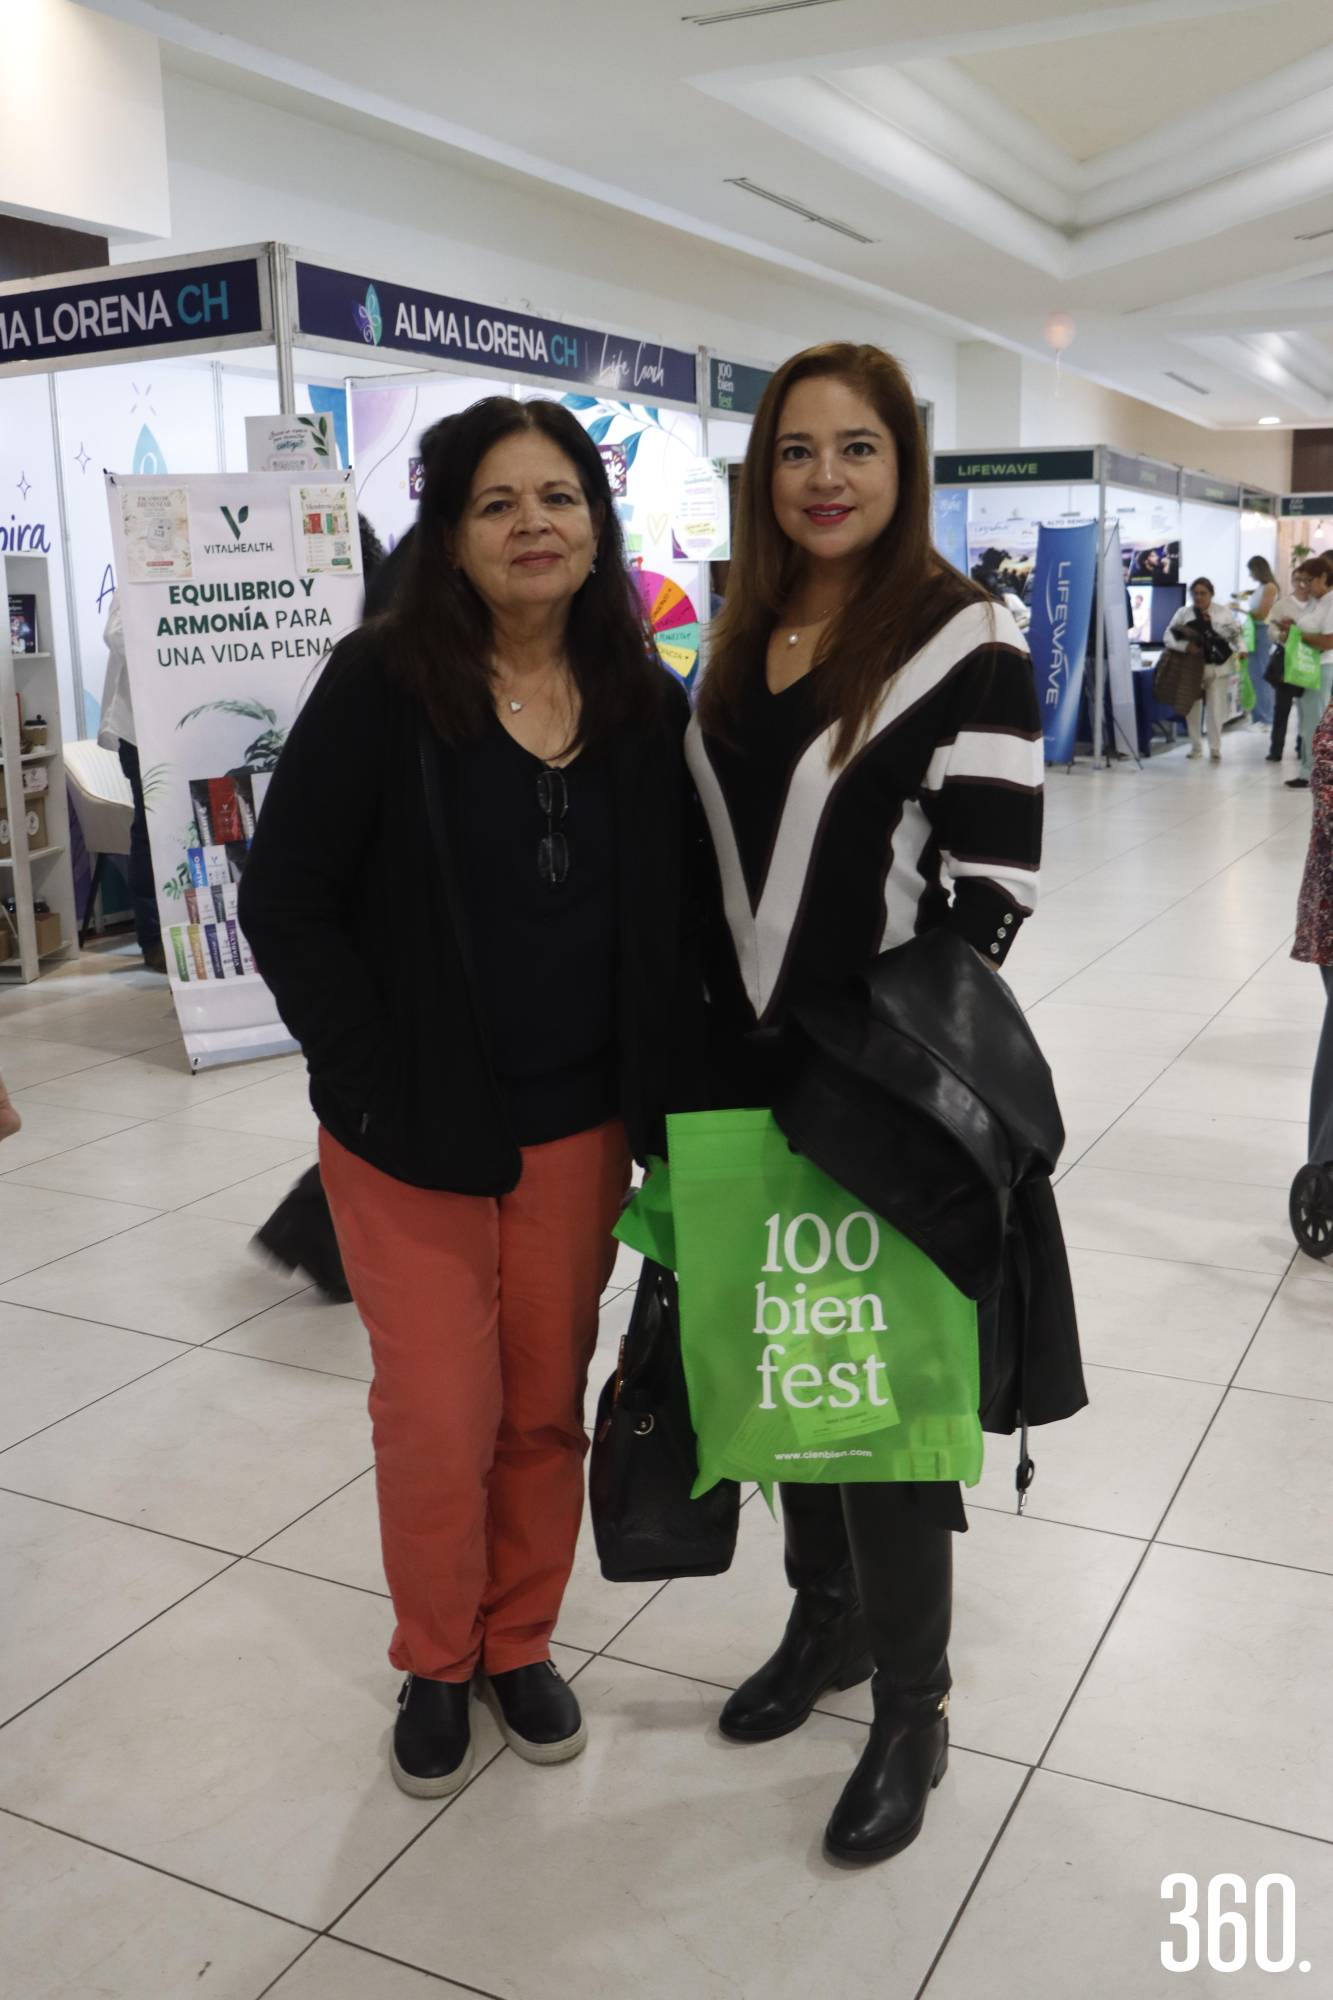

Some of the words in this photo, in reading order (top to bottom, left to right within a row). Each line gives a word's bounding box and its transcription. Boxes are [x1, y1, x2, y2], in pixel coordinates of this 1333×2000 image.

[34, 289, 172, 345] LORENA
[177, 280, 229, 325] CH
[394, 302, 462, 347] ALMA
[465, 315, 549, 363] LORENA
[551, 334, 578, 368] CH
[599, 333, 630, 383] Life
[958, 463, 1039, 476] LIFEWAVE
[203, 542, 273, 554] VITALHEALTH
[168, 580, 295, 606] EQUILIBRIO
[300, 578, 315, 597] Y
[157, 606, 269, 636] ARMONÍA
[275, 608, 332, 628] PARA
[1045, 561, 1072, 705] LIFEWAVE
[157, 646, 206, 667] UNA
[211, 642, 264, 663] VIDA
[271, 637, 335, 659] PLENA
[761, 1210, 880, 1274] 100
[752, 1281, 888, 1336] bien
[756, 1344, 889, 1409] fest
[774, 1449, 872, 1460] www.cienbien.com
